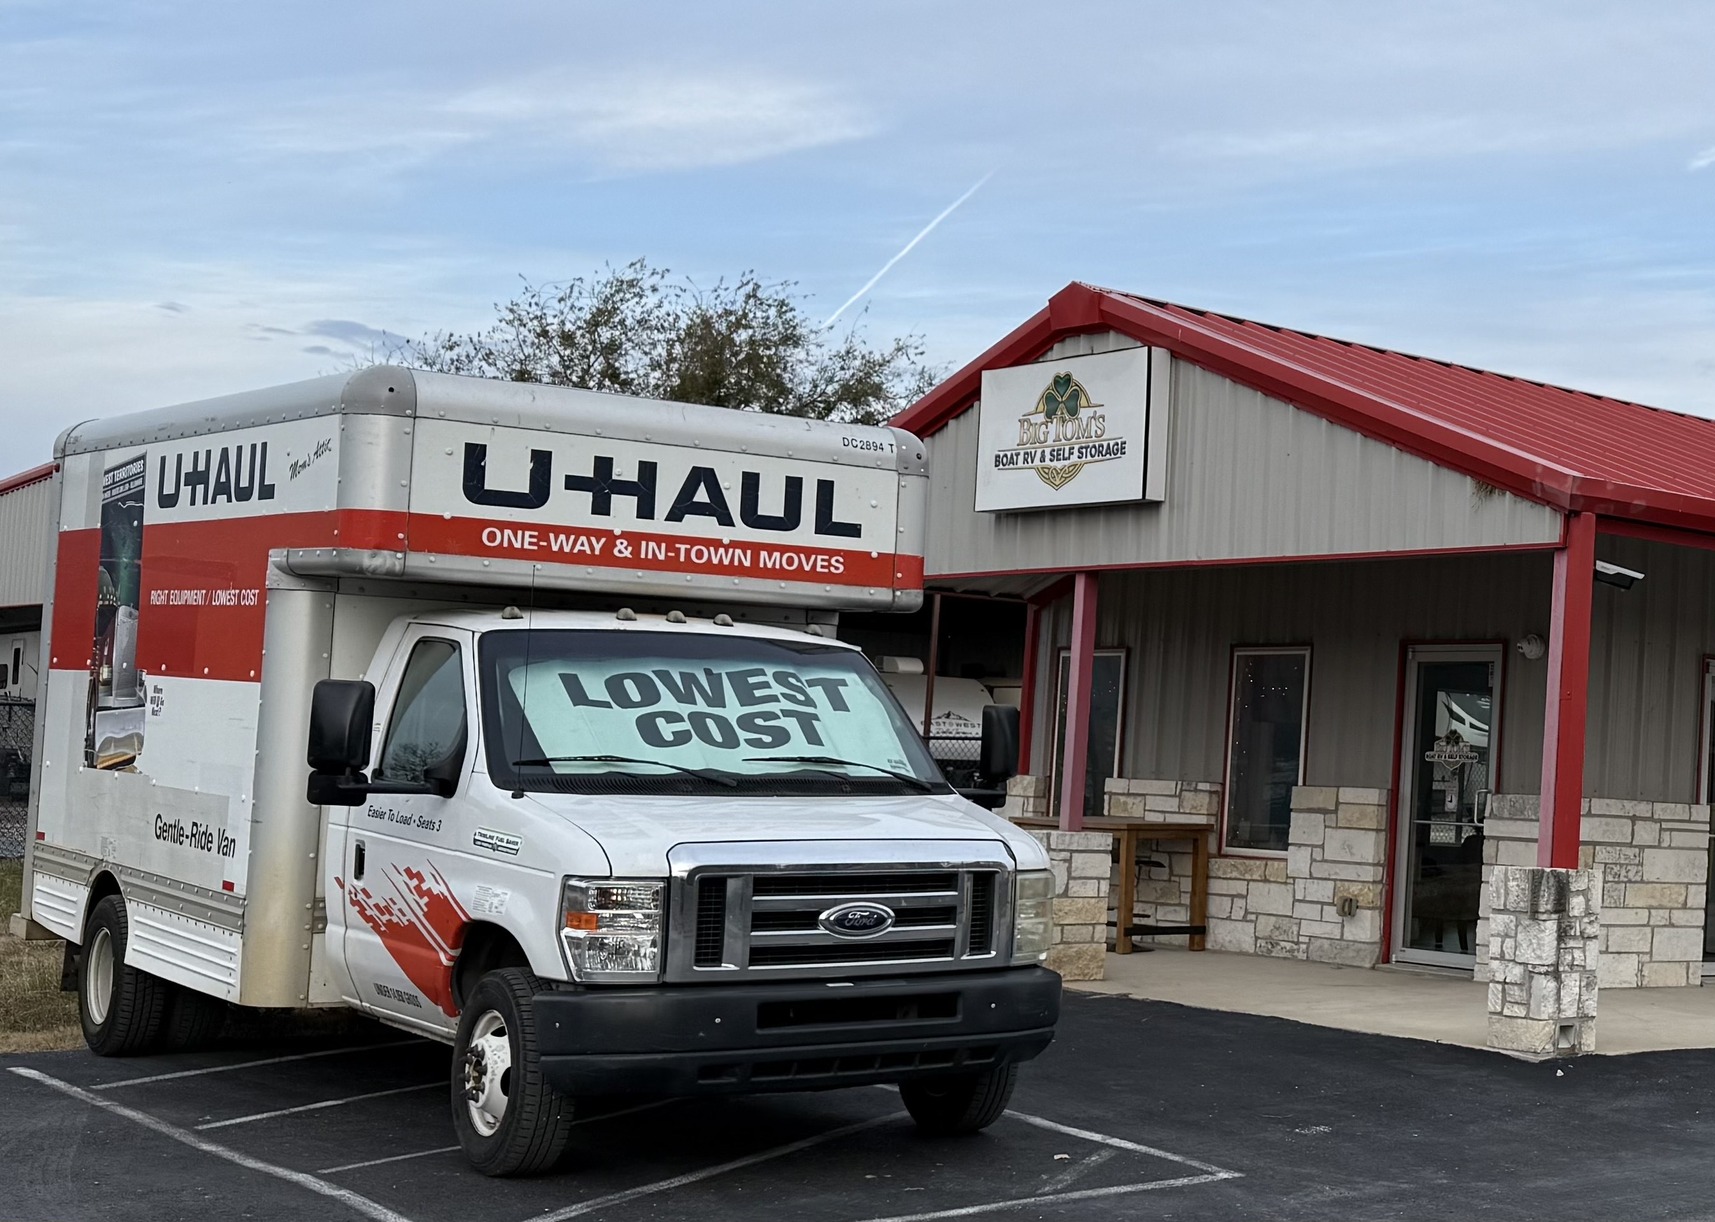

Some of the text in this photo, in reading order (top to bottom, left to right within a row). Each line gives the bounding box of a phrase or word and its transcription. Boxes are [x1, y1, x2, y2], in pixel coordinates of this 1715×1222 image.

[842, 436, 895, 454] DC2894 T
[1016, 410, 1106, 447] BIG TOM'S
[994, 440, 1127, 468] BOAT RV & SELF STORAGE
[157, 441, 276, 509] U-HAUL
[462, 442, 862, 539] U-HAUL
[481, 526, 845, 575] ONE-WAY & IN-TOWN MOVES
[150, 590, 169, 606] RIGHT
[169, 589, 206, 606] EQUIPMENT
[212, 589, 241, 606] LOWEST
[240, 589, 260, 606] COST
[558, 667, 850, 713] LOWEST
[635, 709, 825, 750] COST
[154, 813, 214, 853] Gentle-Ride
[217, 827, 236, 858] Van
[367, 804, 443, 832] Easier To Load Seats 3
[844, 911, 877, 927] Ford
